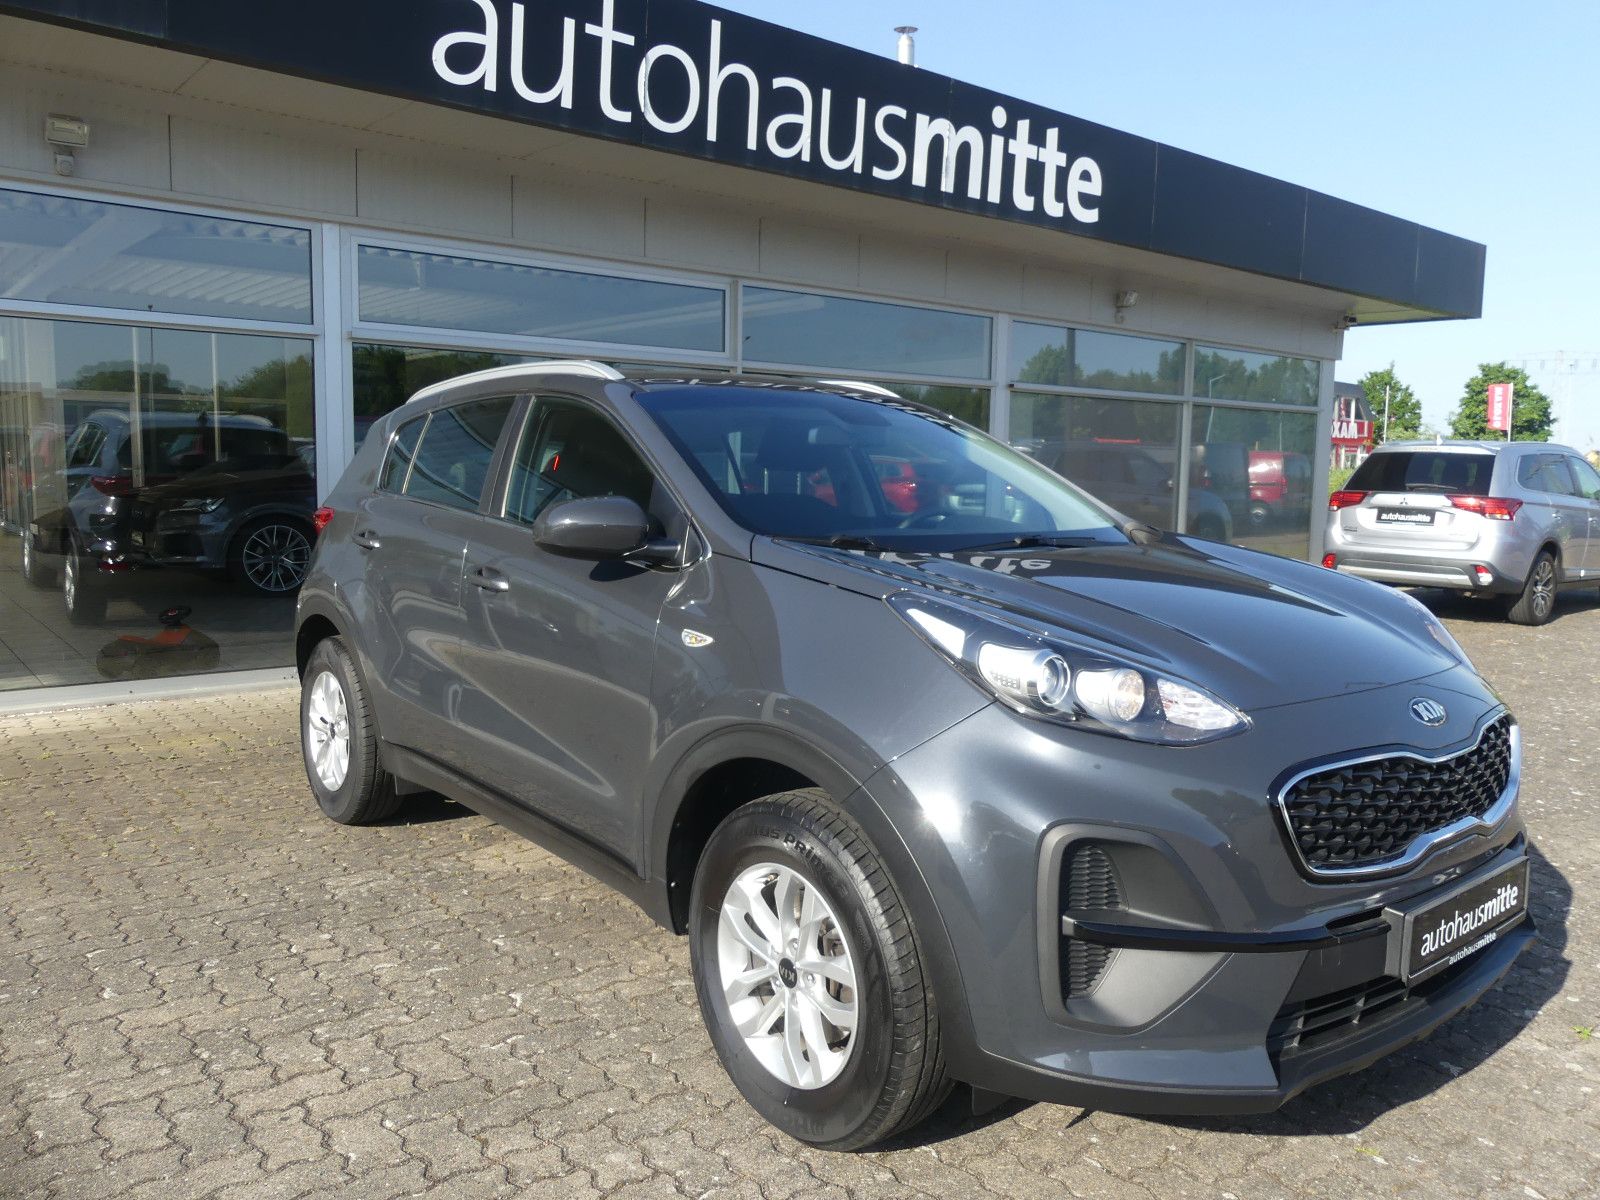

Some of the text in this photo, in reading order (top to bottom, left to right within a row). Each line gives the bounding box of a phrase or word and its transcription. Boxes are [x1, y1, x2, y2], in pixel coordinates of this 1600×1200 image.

[431, 0, 1102, 224] autohausmitte
[1420, 883, 1519, 956] autohausmitte
[1448, 932, 1497, 965] autohausmitte
